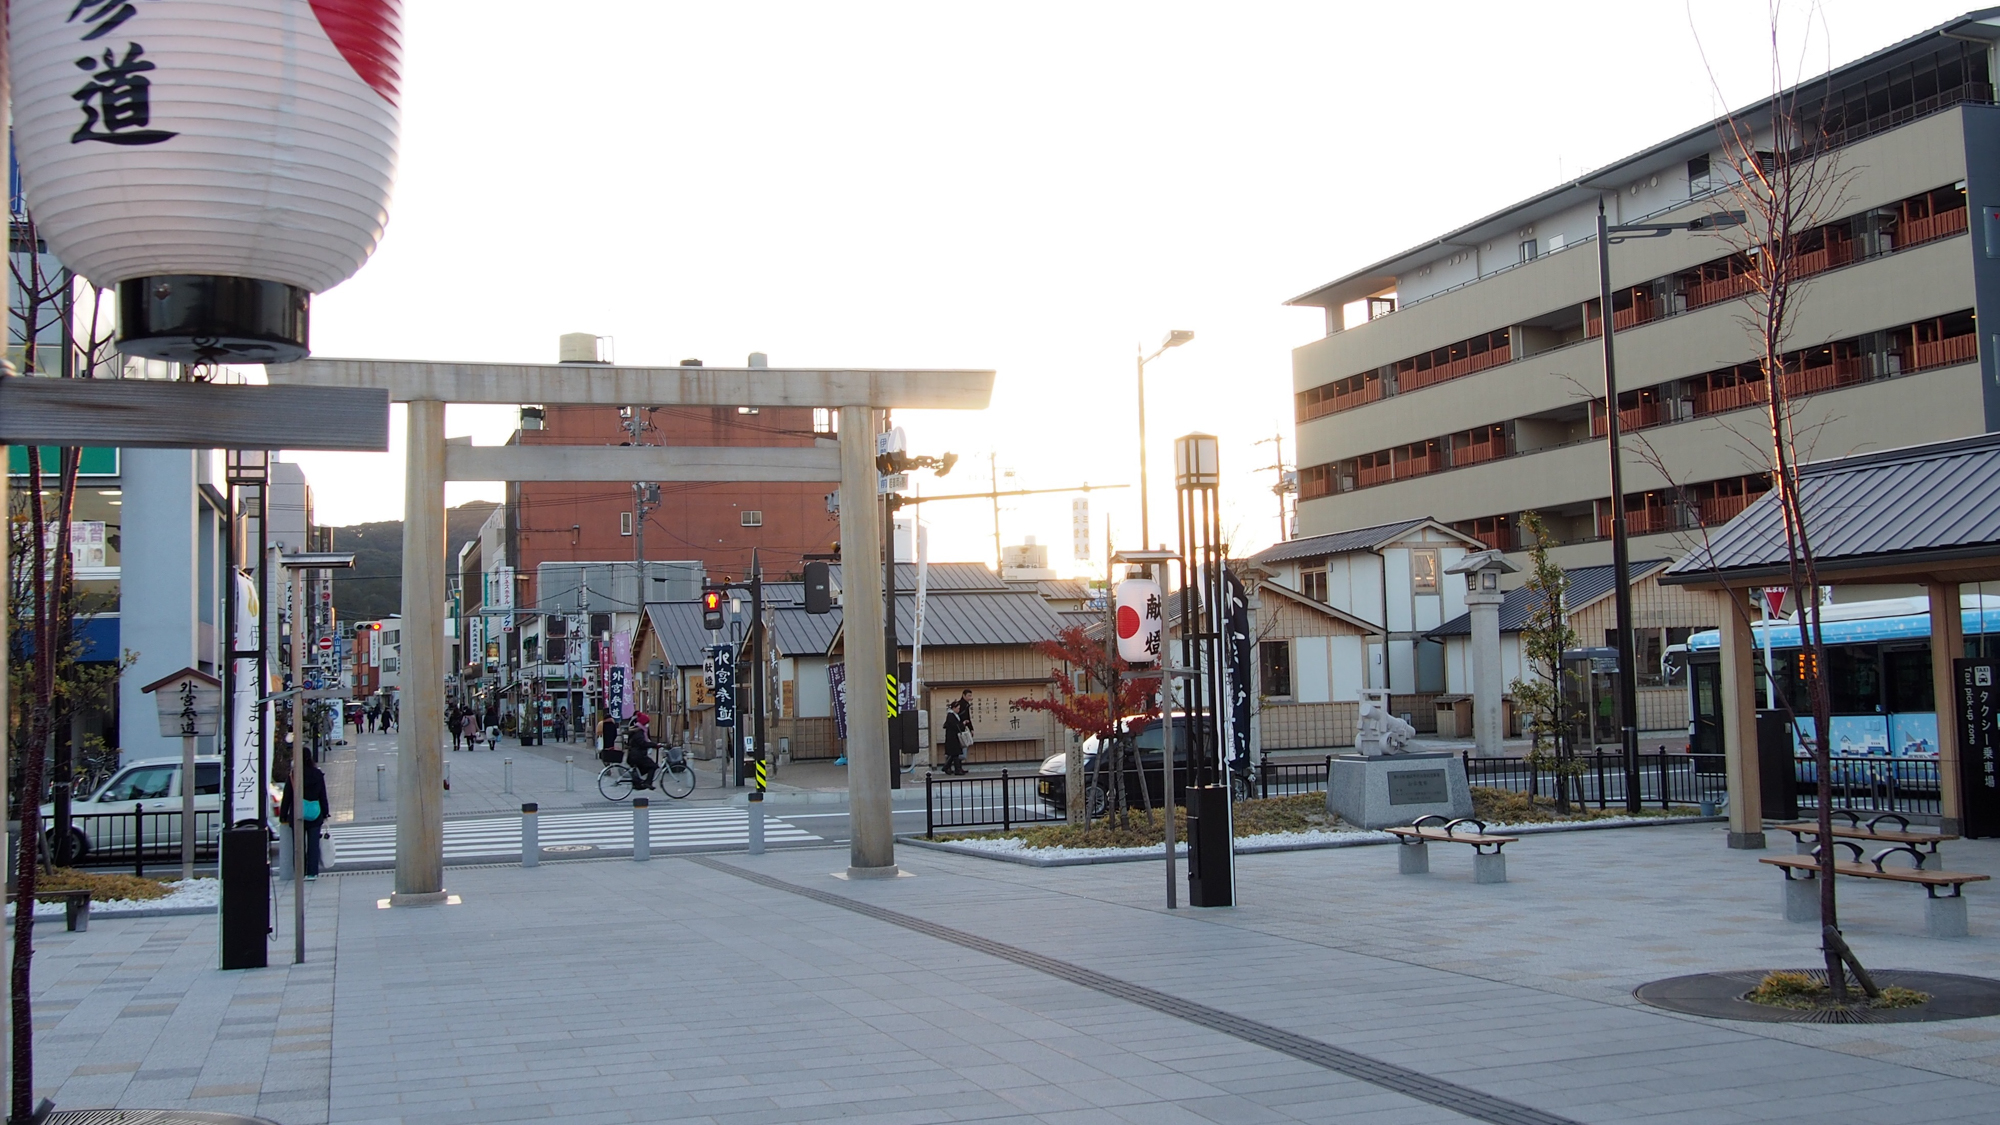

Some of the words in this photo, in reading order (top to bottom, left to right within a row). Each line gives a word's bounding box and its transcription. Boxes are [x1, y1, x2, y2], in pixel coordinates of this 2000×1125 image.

[1964, 666, 1973, 686] Taxi
[180, 680, 199, 735] 外宮参道
[1964, 688, 1974, 721] pick-up
[1980, 690, 1995, 788] タクシー乗車場
